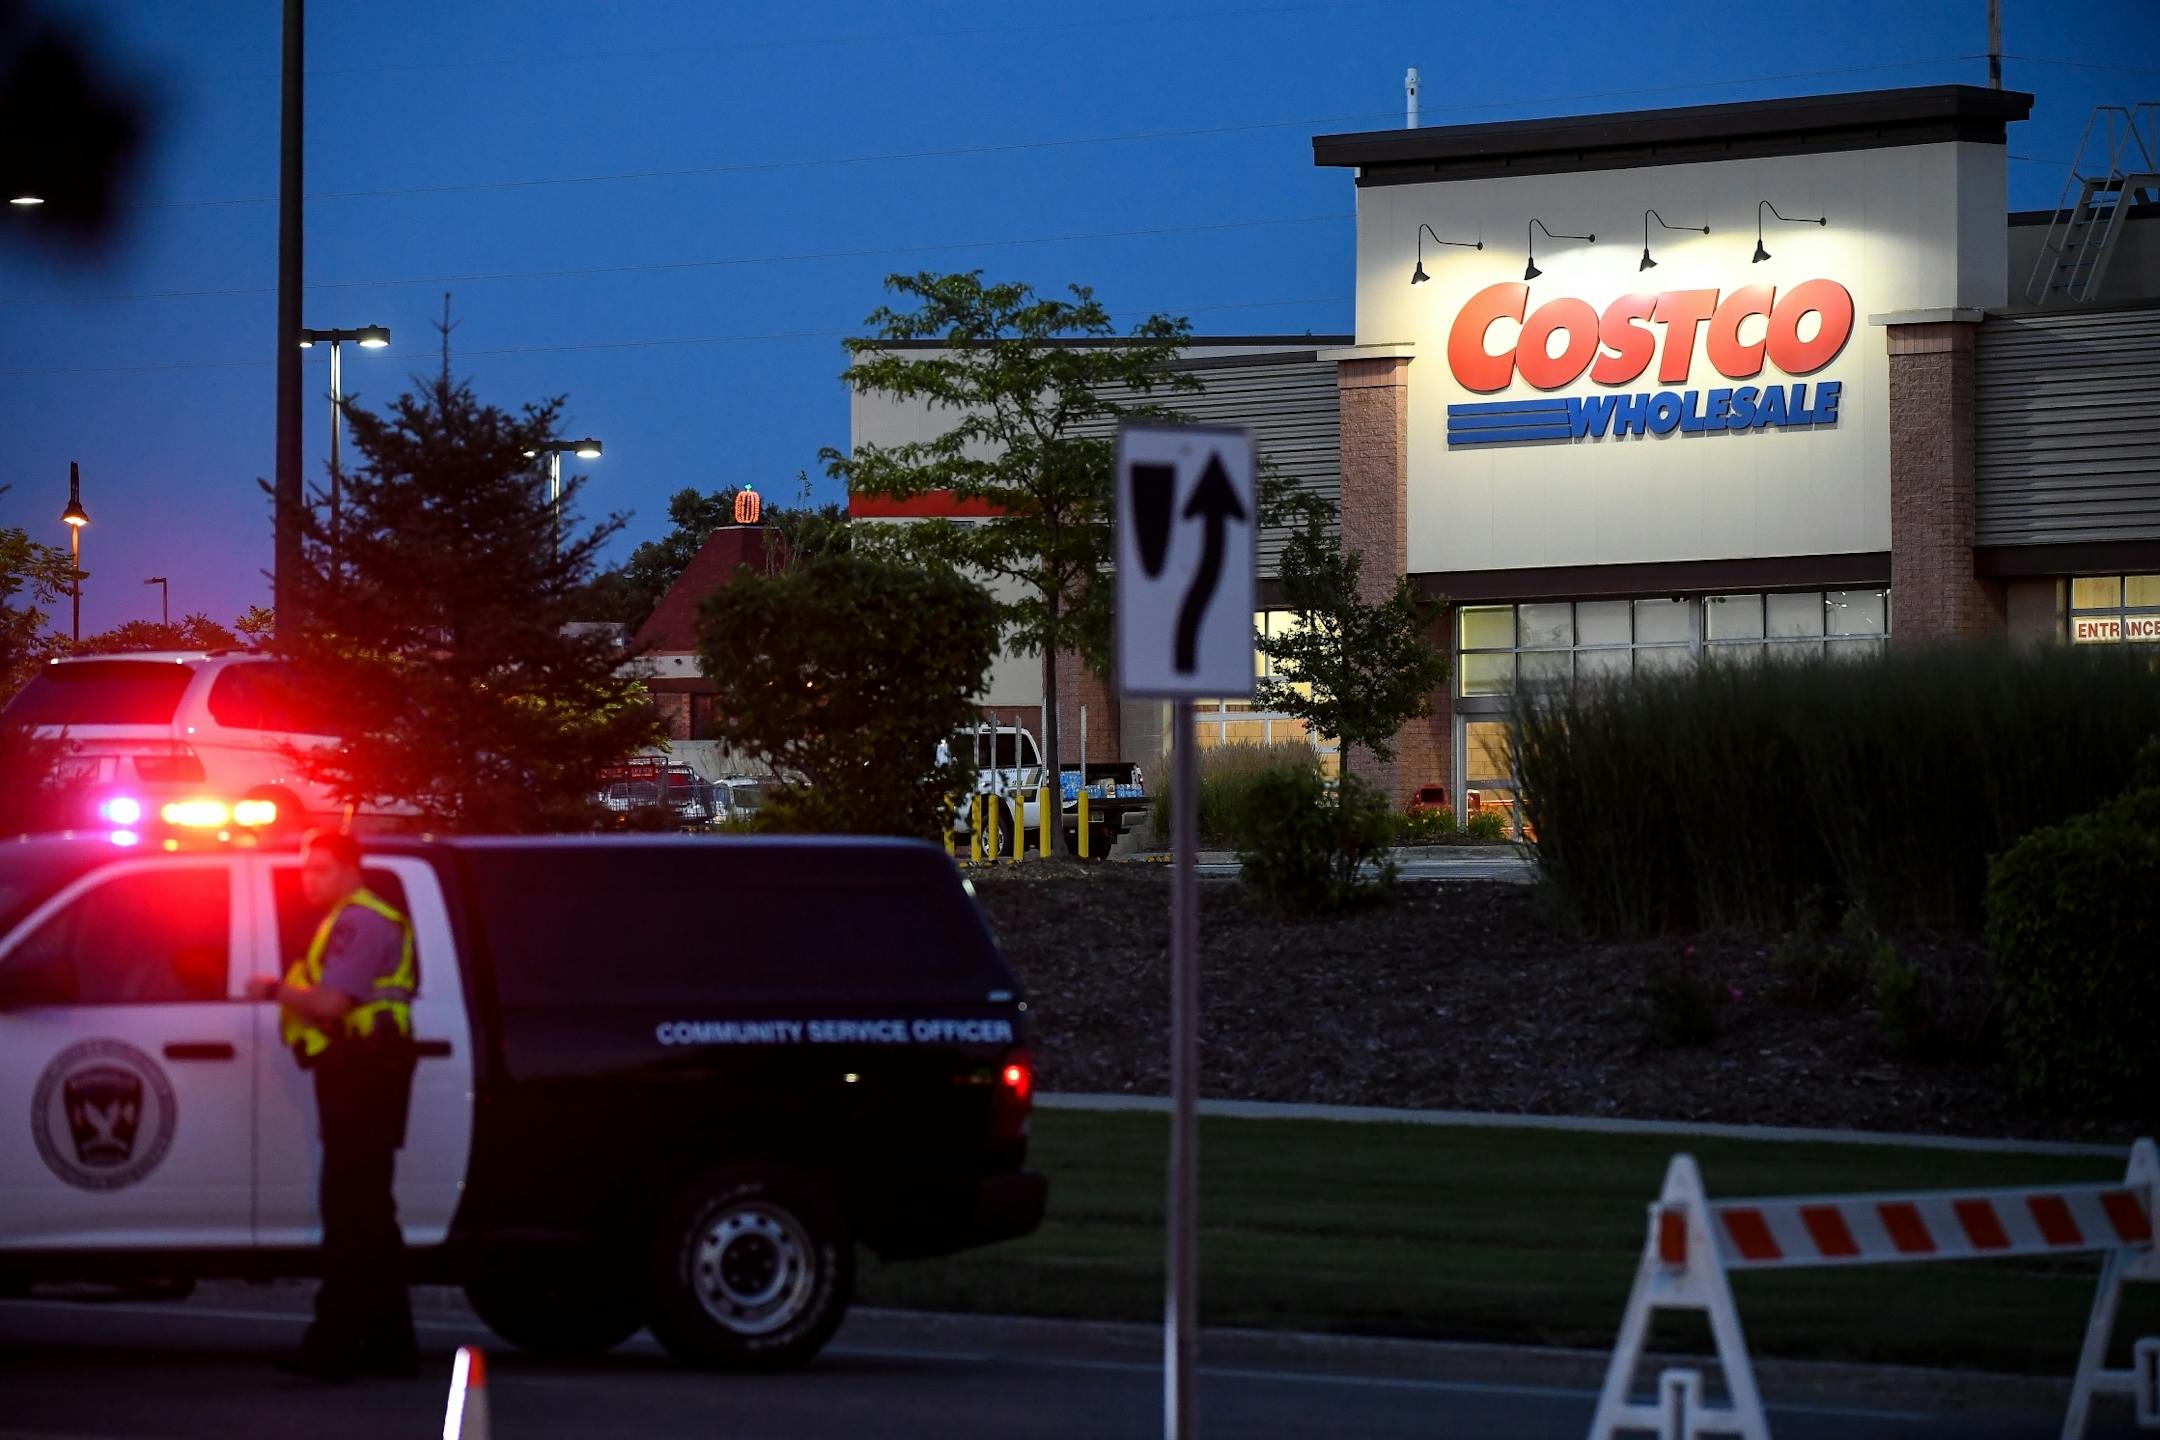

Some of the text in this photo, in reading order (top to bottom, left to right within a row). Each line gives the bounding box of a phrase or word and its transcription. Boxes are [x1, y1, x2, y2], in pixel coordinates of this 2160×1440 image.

[1448, 279, 1855, 393] COSTCO
[1567, 381, 1841, 438] WHOLESALE
[656, 1019, 1013, 1045] COMMUNITY SERVICE OFFICER
